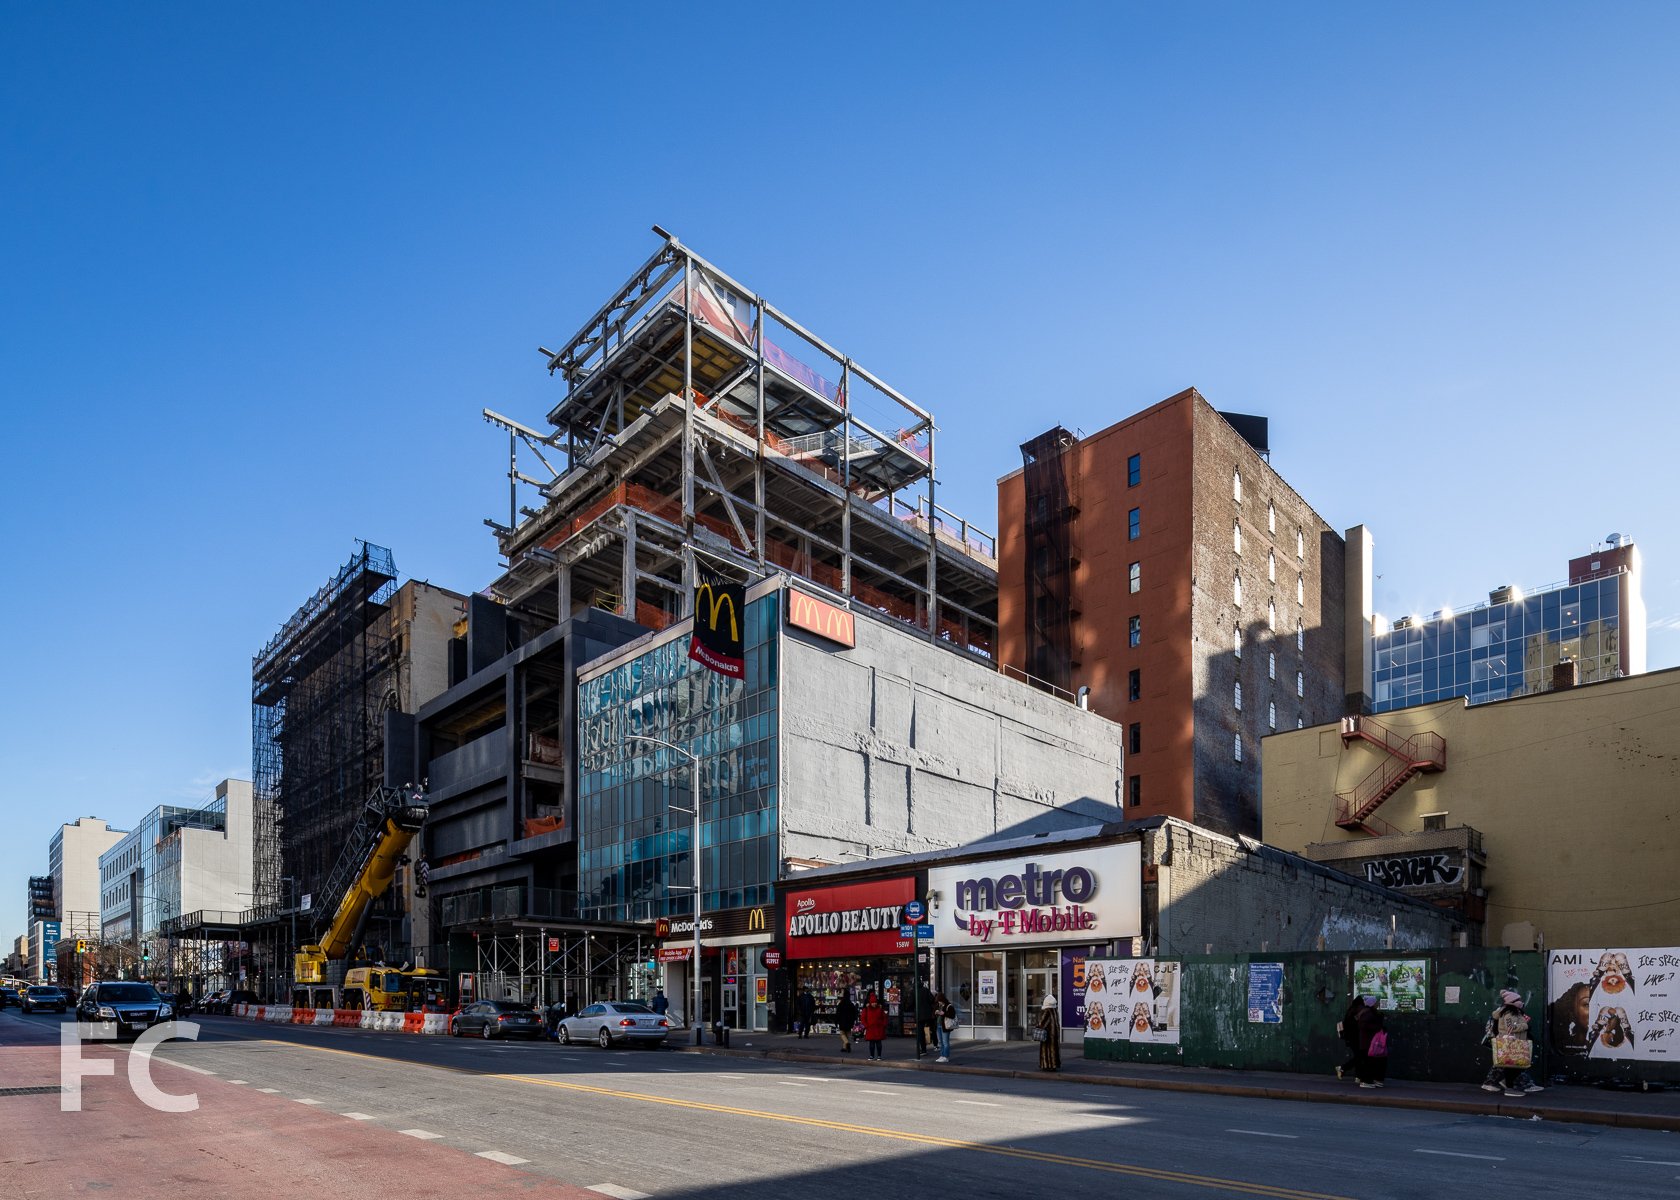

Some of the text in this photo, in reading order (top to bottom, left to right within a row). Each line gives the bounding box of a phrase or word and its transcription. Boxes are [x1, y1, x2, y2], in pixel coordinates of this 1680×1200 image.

[695, 646, 739, 673] McDonald's
[956, 863, 1096, 912] metro
[797, 898, 815, 908] Apollo
[671, 920, 713, 933] McDonld's
[789, 906, 902, 936] APOLLO BEAUTY
[969, 914, 994, 942] by
[1552, 954, 1582, 965] AMI
[1638, 954, 1680, 968] ICE SPICE
[1073, 964, 1085, 988] 5
[1638, 1010, 1680, 1023] ICE SPICE
